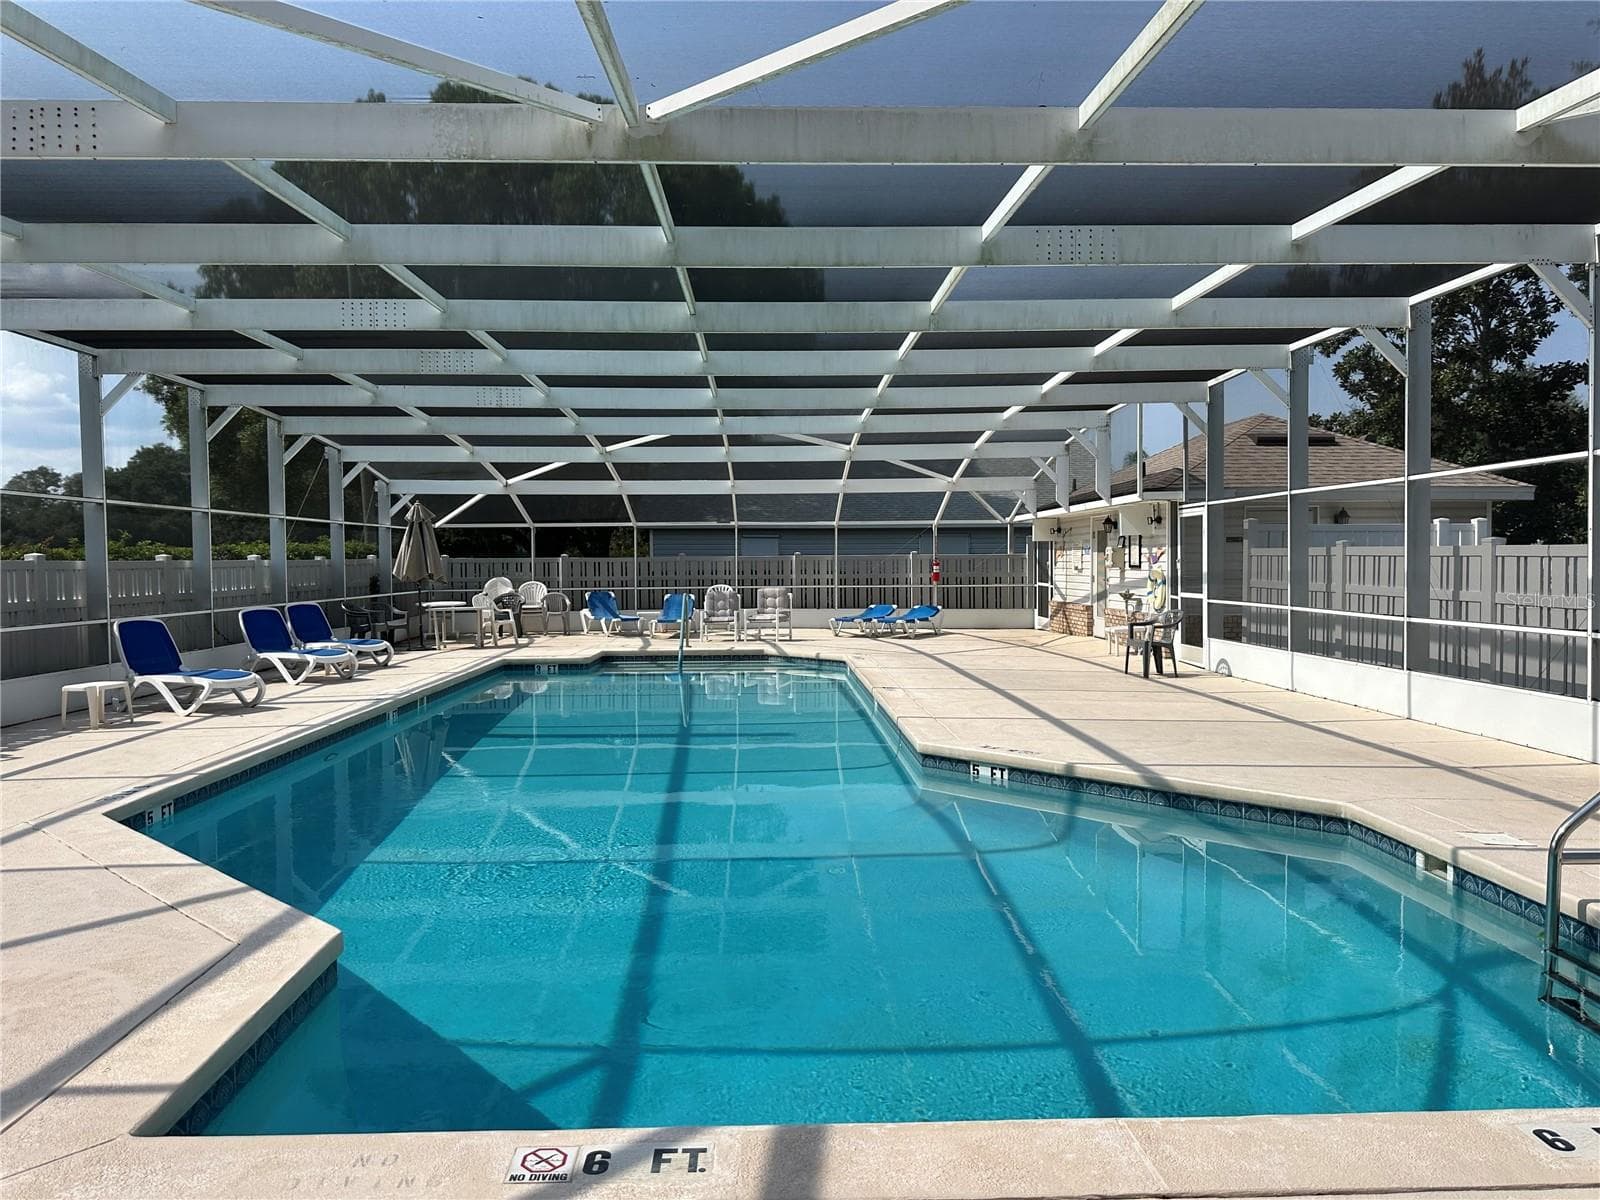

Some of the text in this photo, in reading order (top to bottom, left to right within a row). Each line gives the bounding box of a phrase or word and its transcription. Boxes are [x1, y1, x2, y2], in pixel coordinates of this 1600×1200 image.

[972, 764, 1006, 780] 5 FT
[161, 802, 173, 820] FT
[1532, 1128, 1577, 1152] 6
[582, 1147, 708, 1175] 6 FT.
[508, 1173, 568, 1182] NO DIVING
